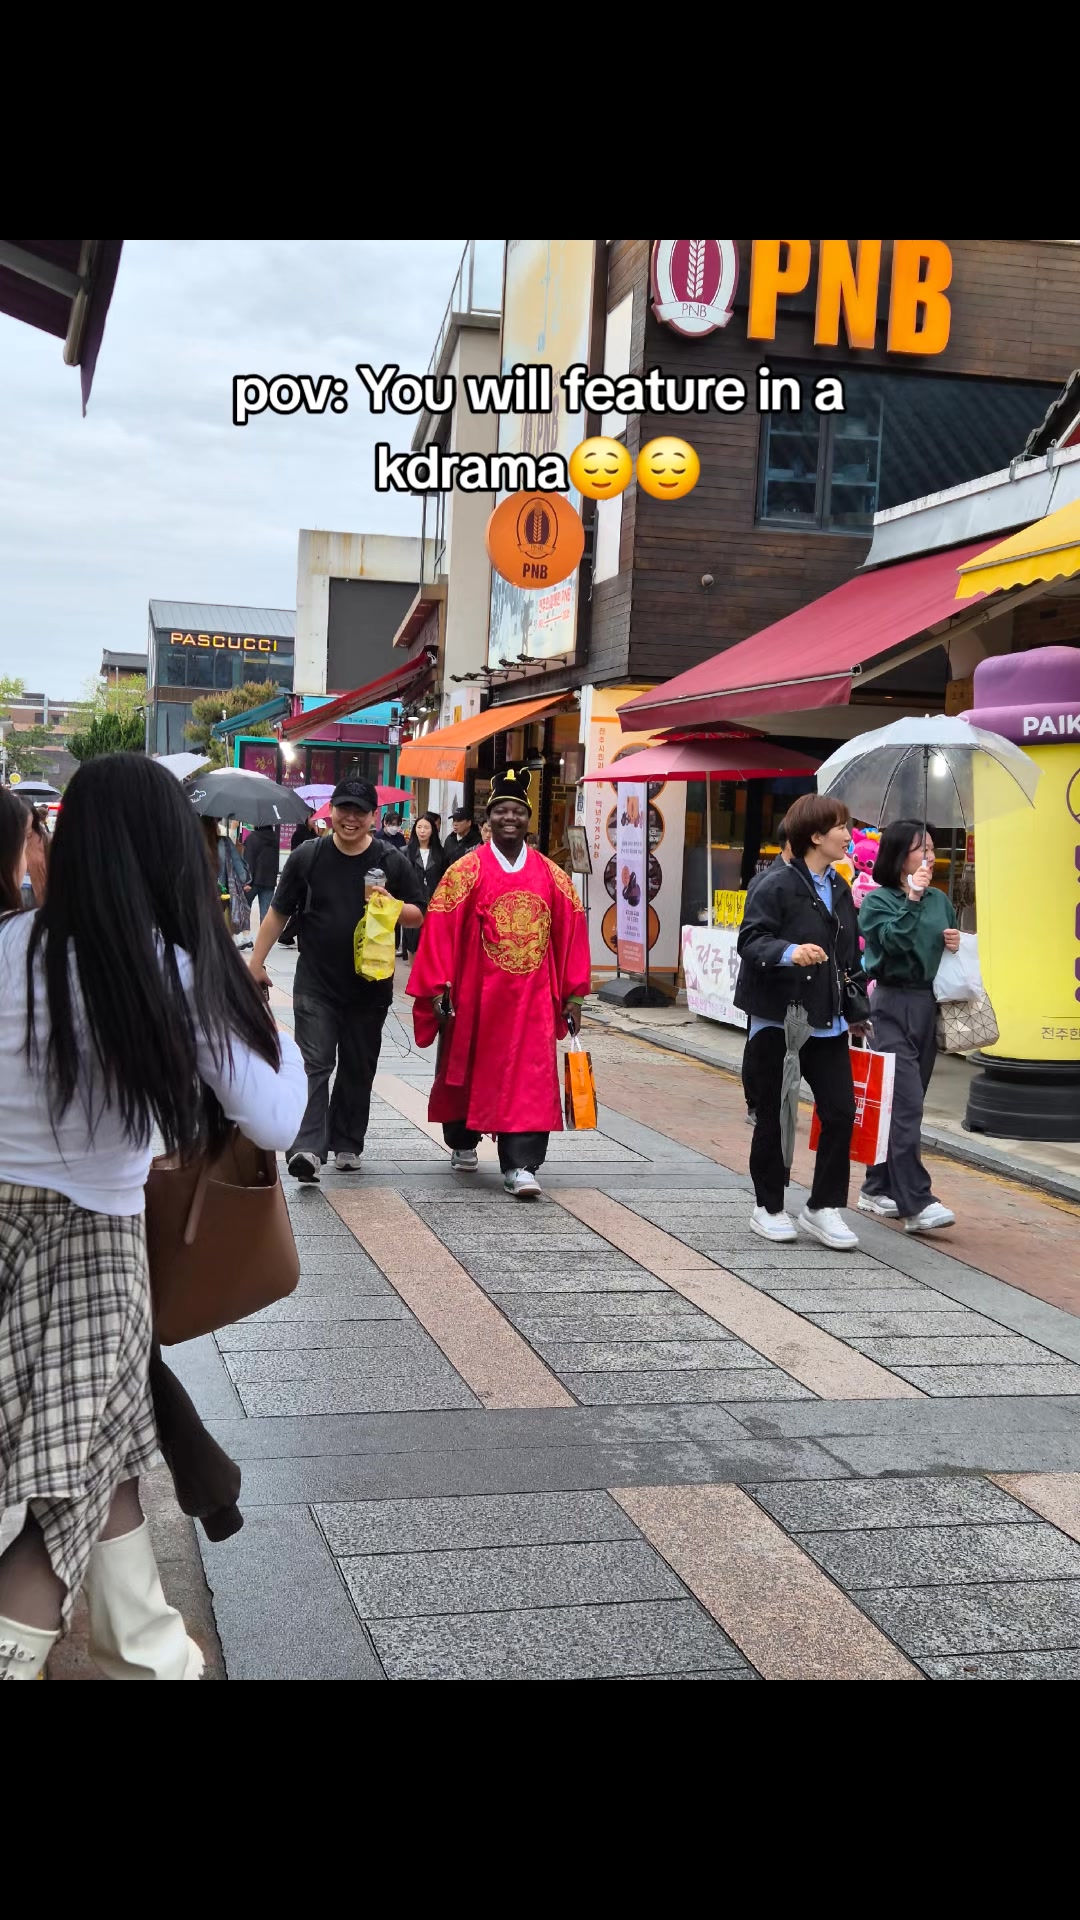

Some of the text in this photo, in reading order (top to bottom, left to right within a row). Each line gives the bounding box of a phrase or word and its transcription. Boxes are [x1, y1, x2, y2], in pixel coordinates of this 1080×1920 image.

[746, 240, 953, 355] PNB
[681, 302, 708, 318] PNB
[522, 562, 548, 580] PNB
[170, 632, 277, 652] PASCUCCI
